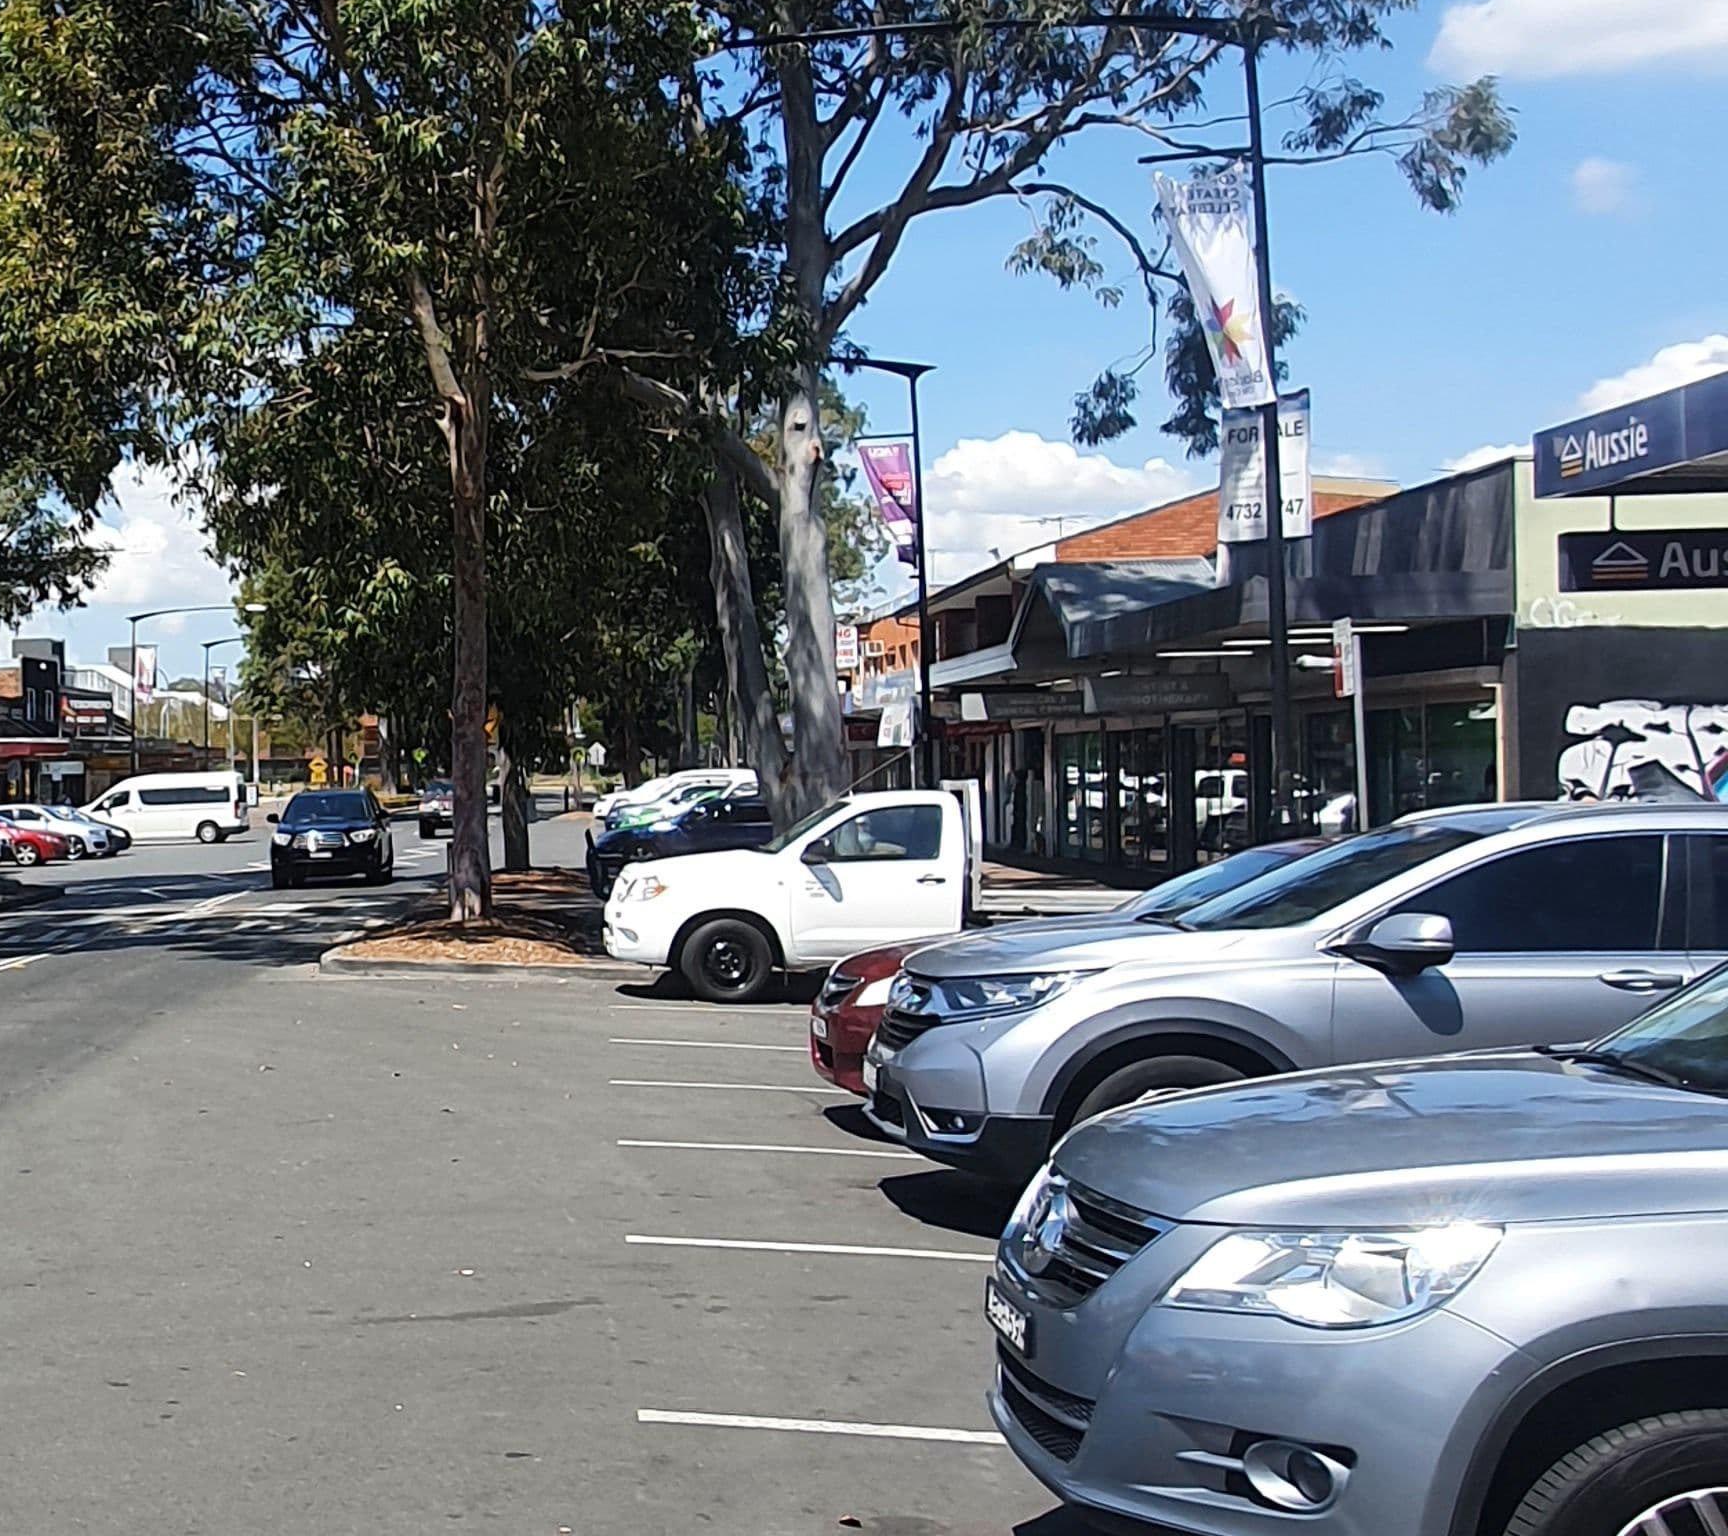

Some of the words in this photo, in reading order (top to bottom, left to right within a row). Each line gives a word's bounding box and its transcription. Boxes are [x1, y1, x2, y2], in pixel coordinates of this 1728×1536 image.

[1227, 426, 1259, 444] FOR
[1584, 416, 1649, 471] Aussie
[1226, 502, 1262, 521] 4732
[1659, 542, 1728, 578] Au
